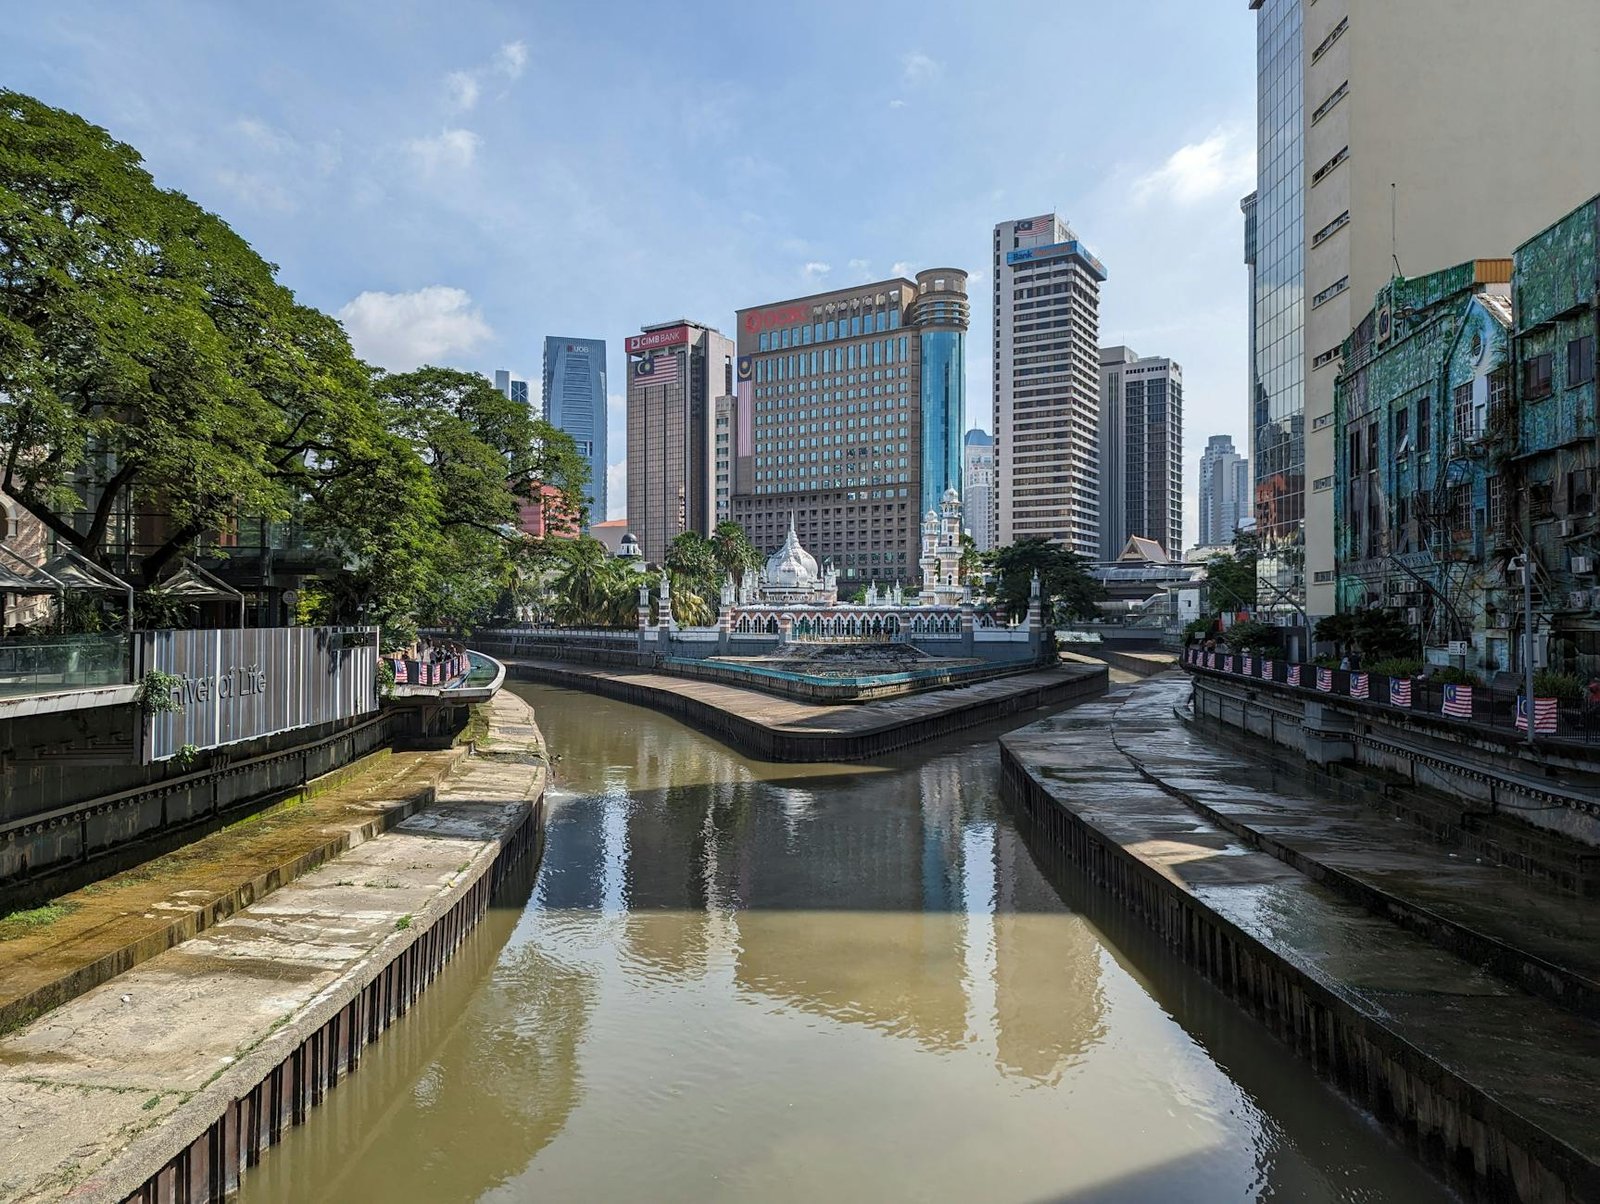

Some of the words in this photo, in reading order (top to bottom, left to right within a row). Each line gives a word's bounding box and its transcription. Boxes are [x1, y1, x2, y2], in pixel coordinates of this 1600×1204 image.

[1013, 249, 1033, 260] Bank
[641, 335, 660, 346] CIMB
[661, 331, 680, 343] BANK
[218, 665, 236, 699] of
[239, 663, 267, 697] Life
